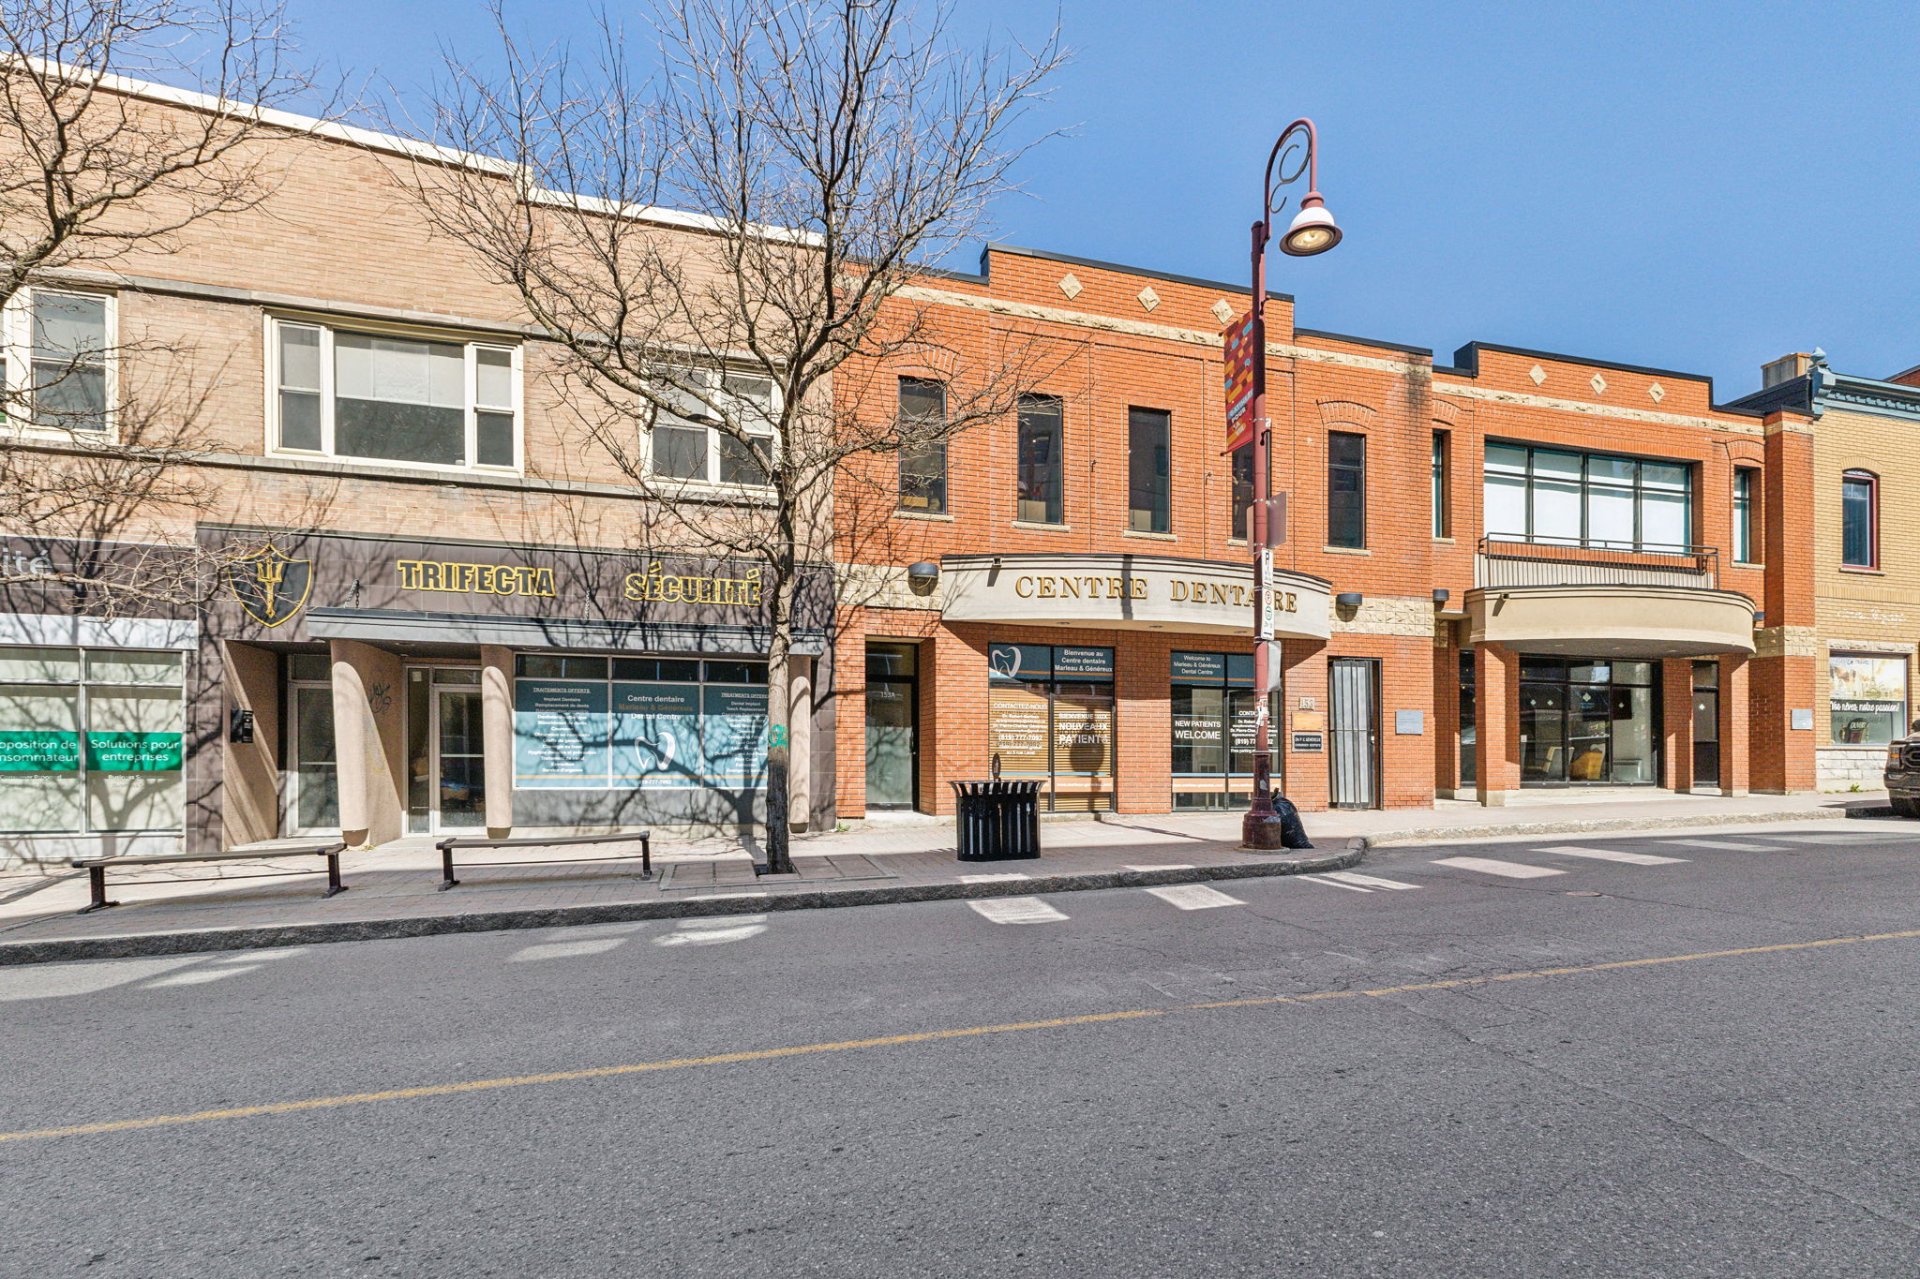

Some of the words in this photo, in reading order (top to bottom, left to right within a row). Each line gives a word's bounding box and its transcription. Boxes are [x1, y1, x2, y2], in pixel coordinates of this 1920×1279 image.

[397, 560, 556, 597] TRIFECTA
[625, 562, 762, 606] SÉCURITÉ
[1015, 575, 1148, 600] CENTRE
[1170, 579, 1298, 613] DENTARE
[1063, 649, 1095, 657] Bienvenue
[627, 694, 653, 702] Centre
[654, 695, 685, 703] dentaire
[1058, 722, 1108, 731] NOUVEAUX
[1191, 720, 1222, 728] PATIENTS
[1058, 733, 1109, 745] PATIENTS
[1174, 730, 1222, 739] WELCOME
[60, 739, 76, 749] de
[91, 739, 148, 749] Solutions
[150, 741, 180, 754] pour
[102, 753, 169, 763] entreprises
